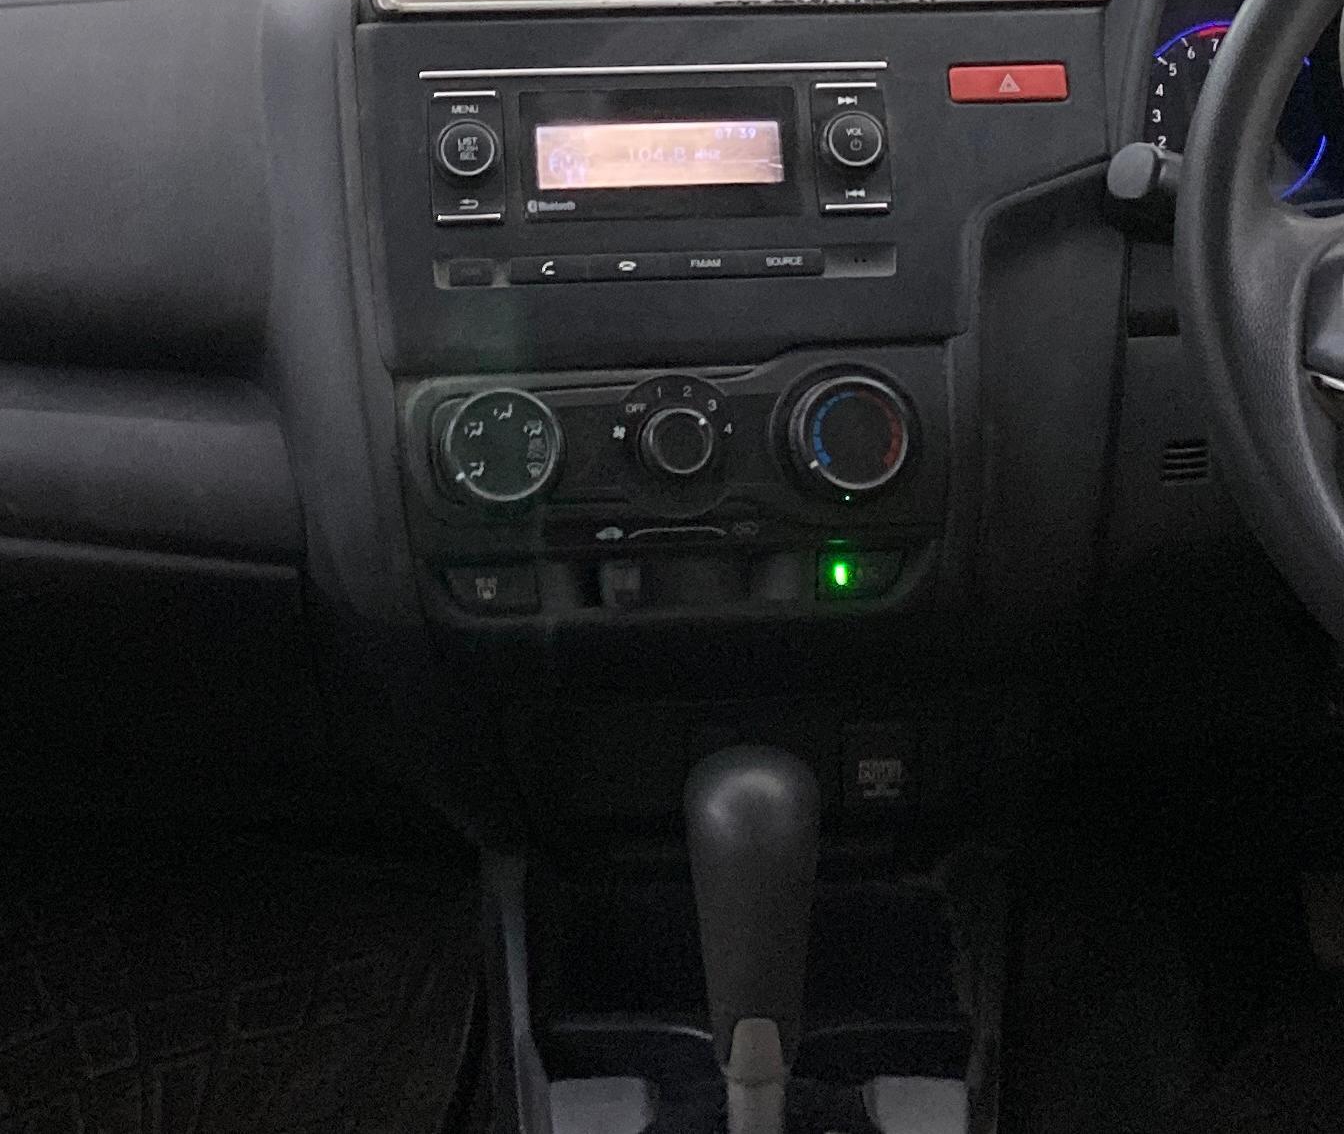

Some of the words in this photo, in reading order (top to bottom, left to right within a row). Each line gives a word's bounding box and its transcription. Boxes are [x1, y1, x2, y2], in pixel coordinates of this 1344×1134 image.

[1211, 38, 1220, 52] 7
[1187, 46, 1196, 60] 6
[1168, 62, 1178, 77] 5
[1155, 83, 1165, 97] 4
[451, 104, 479, 114] MENU
[1152, 108, 1162, 123] 3
[845, 128, 864, 137] VOL
[1157, 135, 1167, 149] 2
[765, 256, 803, 268] SOURCE
[682, 385, 692, 398] 2
[625, 402, 647, 414] OFF
[707, 398, 717, 412] 3
[723, 422, 734, 435] 4
